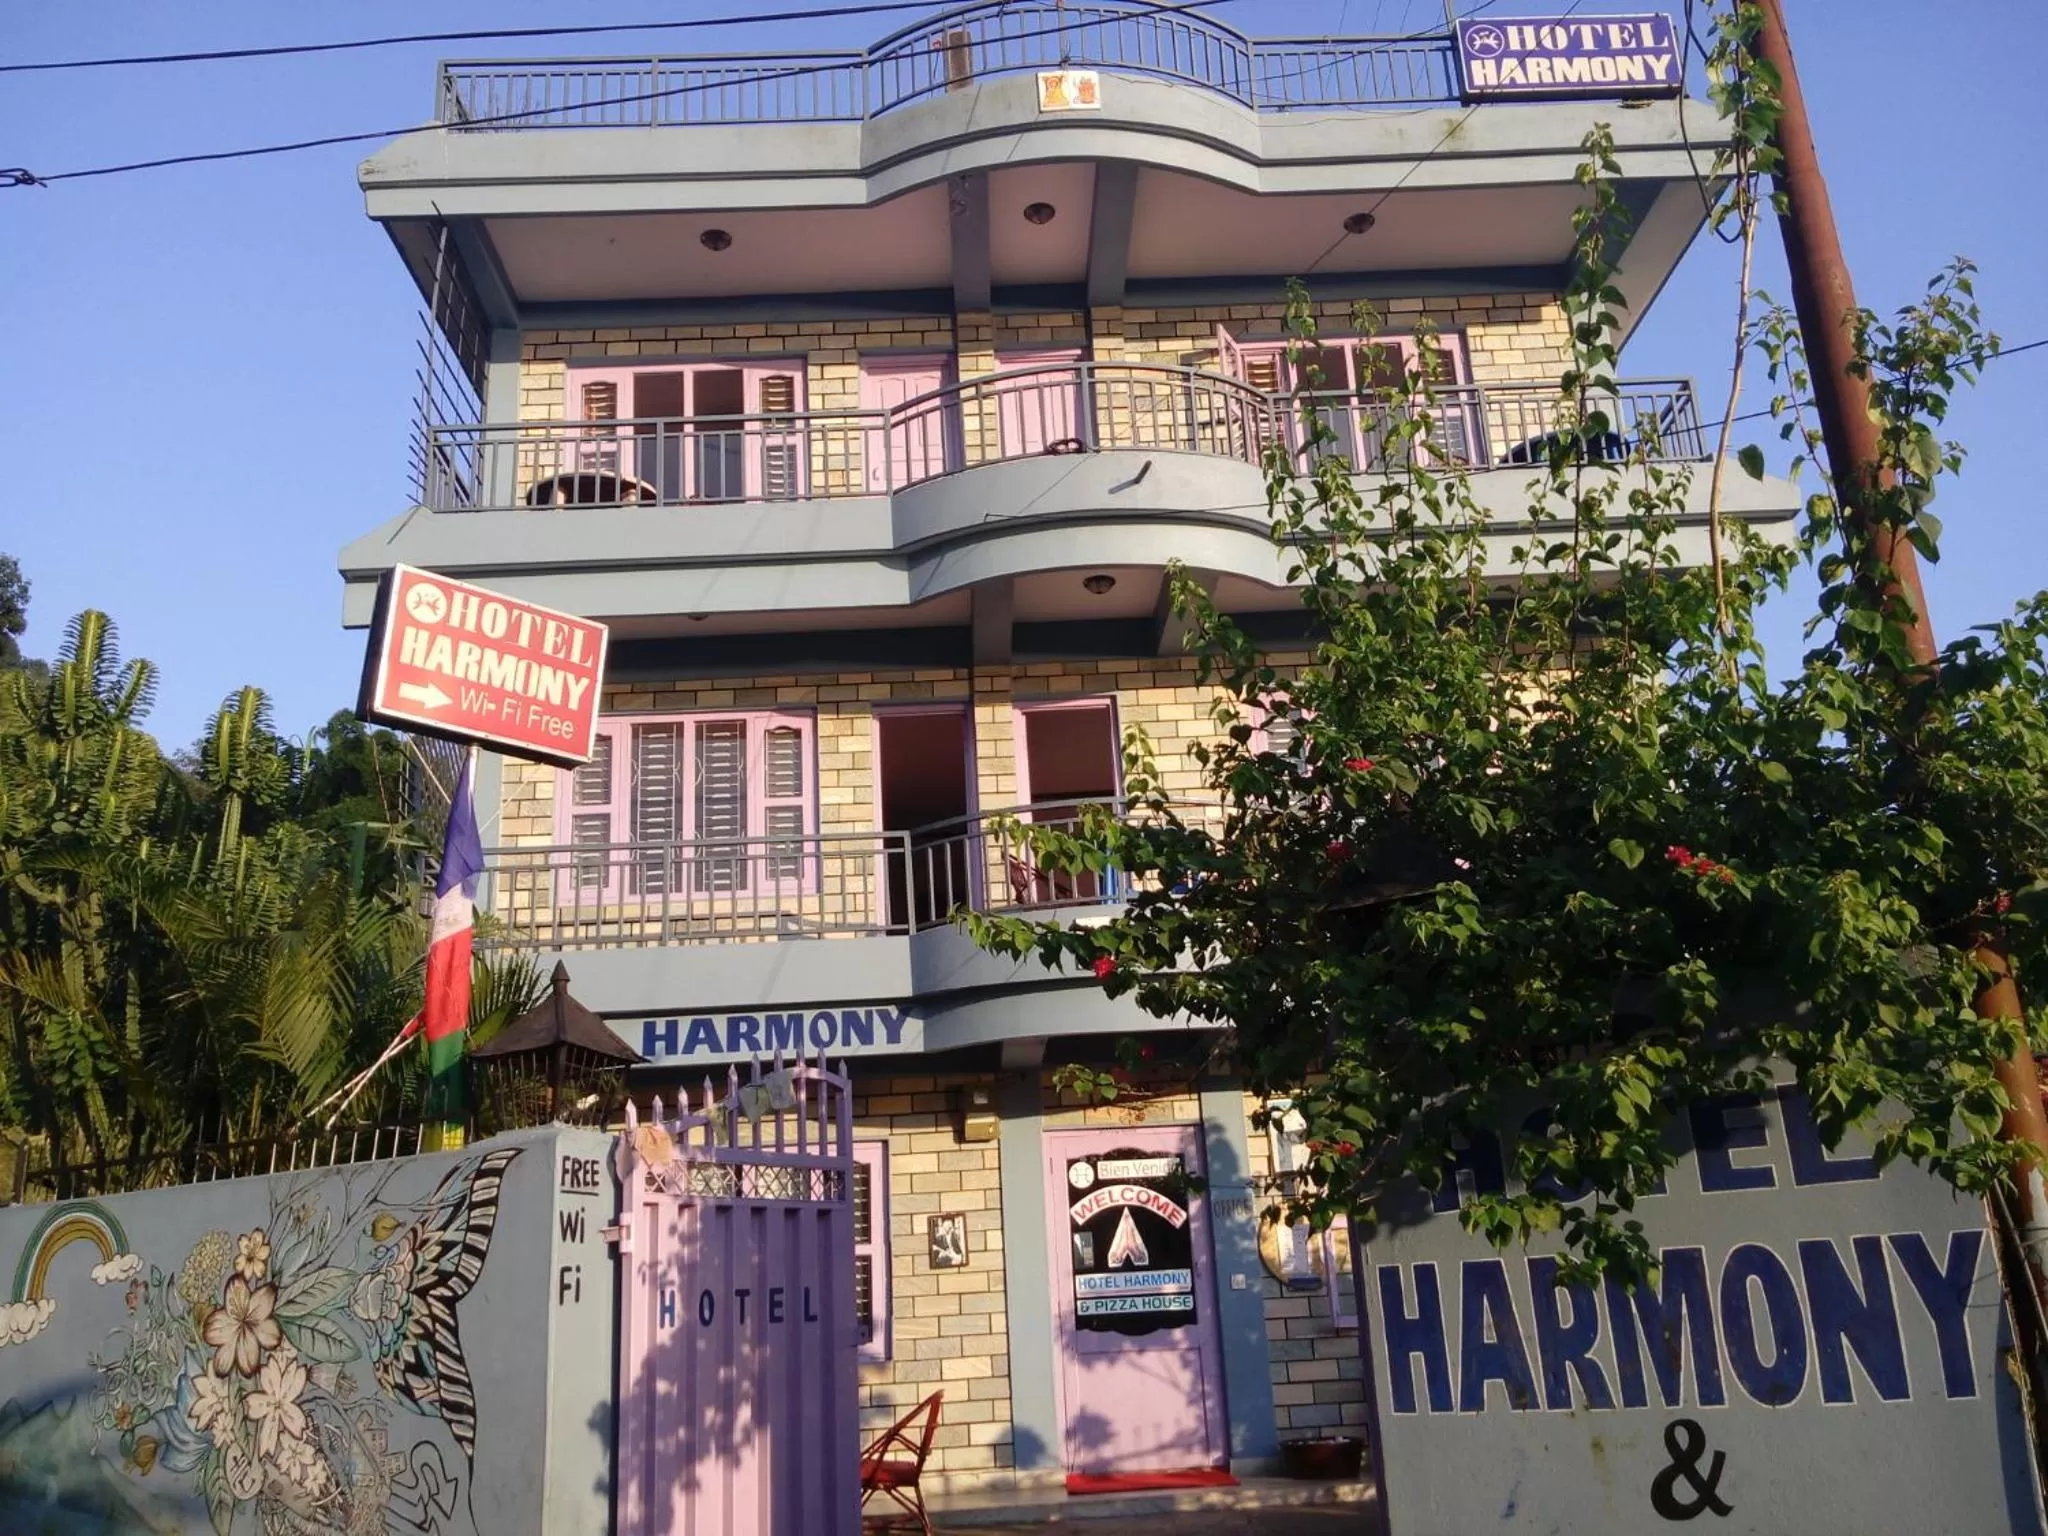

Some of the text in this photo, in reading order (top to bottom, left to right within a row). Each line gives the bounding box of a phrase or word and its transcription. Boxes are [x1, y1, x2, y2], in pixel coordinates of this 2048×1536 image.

[1504, 22, 1669, 51] HOTEL
[1470, 54, 1673, 86] HARMONY
[447, 589, 594, 668] HOTEL
[399, 625, 592, 711] HARMONY
[527, 702, 577, 740] Free
[641, 1008, 910, 1057] HARMONY
[560, 1155, 600, 1189] FREE
[1100, 1162, 1130, 1177] Bien
[1074, 1187, 1184, 1224] WELCOME
[559, 1206, 585, 1244] Wi
[558, 1264, 581, 1307] Fi
[1078, 1271, 1189, 1289] HOTEL HARMONY
[659, 1286, 818, 1329] HOTEL
[1080, 1296, 1191, 1313] & PIZZA HOUSE
[1377, 1228, 1987, 1416] HARMONY
[1650, 1418, 1735, 1522] &
